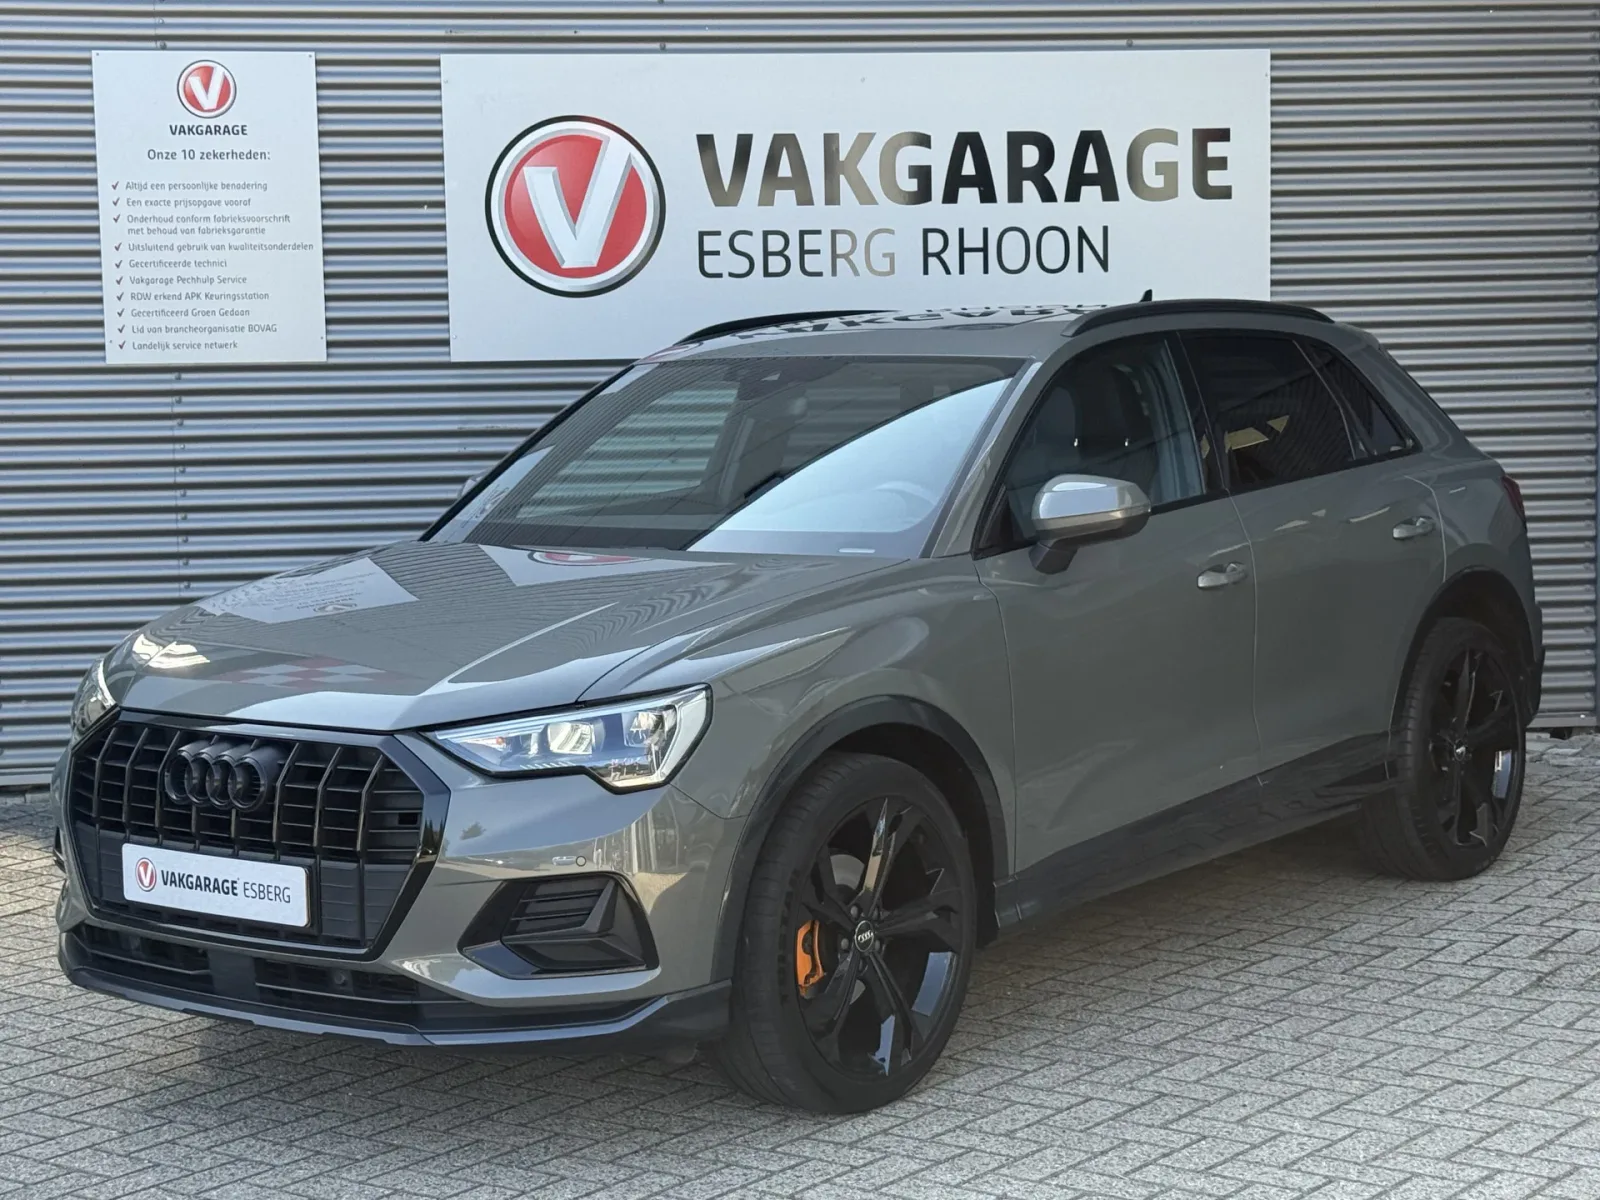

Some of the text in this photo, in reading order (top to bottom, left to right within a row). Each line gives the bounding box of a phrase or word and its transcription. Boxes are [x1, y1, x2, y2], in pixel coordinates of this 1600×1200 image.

[169, 124, 248, 136] VAKGARAGE
[147, 149, 271, 161] Onze 10 zekerheden:
[695, 127, 1233, 208] VAKGARAGE
[125, 182, 148, 192] Altijd
[168, 181, 218, 192] persoonlijke
[220, 182, 268, 192] benadering
[126, 198, 251, 208] Een exacte prijsopgave vooraf
[127, 214, 291, 223] Onderhoud conform fabrieksvoorschrift
[128, 227, 144, 235] met
[146, 226, 178, 235] behoud
[198, 226, 266, 236] fabrieksgarantie
[128, 243, 174, 251] Uitsluitend
[176, 242, 209, 253] gebruik
[228, 242, 314, 251] kwaliteitsonderdelen
[697, 225, 1109, 279] ESBERG RHOON
[128, 259, 228, 268] Gecertificeerde technici
[129, 275, 247, 286] Vakgarage Pechhulp Service
[130, 292, 270, 302] RDW erkend APK Keuringsstation
[131, 308, 250, 317] Gecertificeerd Groen Gedaan
[131, 325, 144, 334] Lid
[165, 324, 245, 335] brancheorganisatie
[248, 324, 277, 333] BOVAG
[132, 341, 238, 351] Landelijk service netwerk
[161, 869, 239, 896] VAKGARAGE
[243, 881, 291, 904] ESBERG
